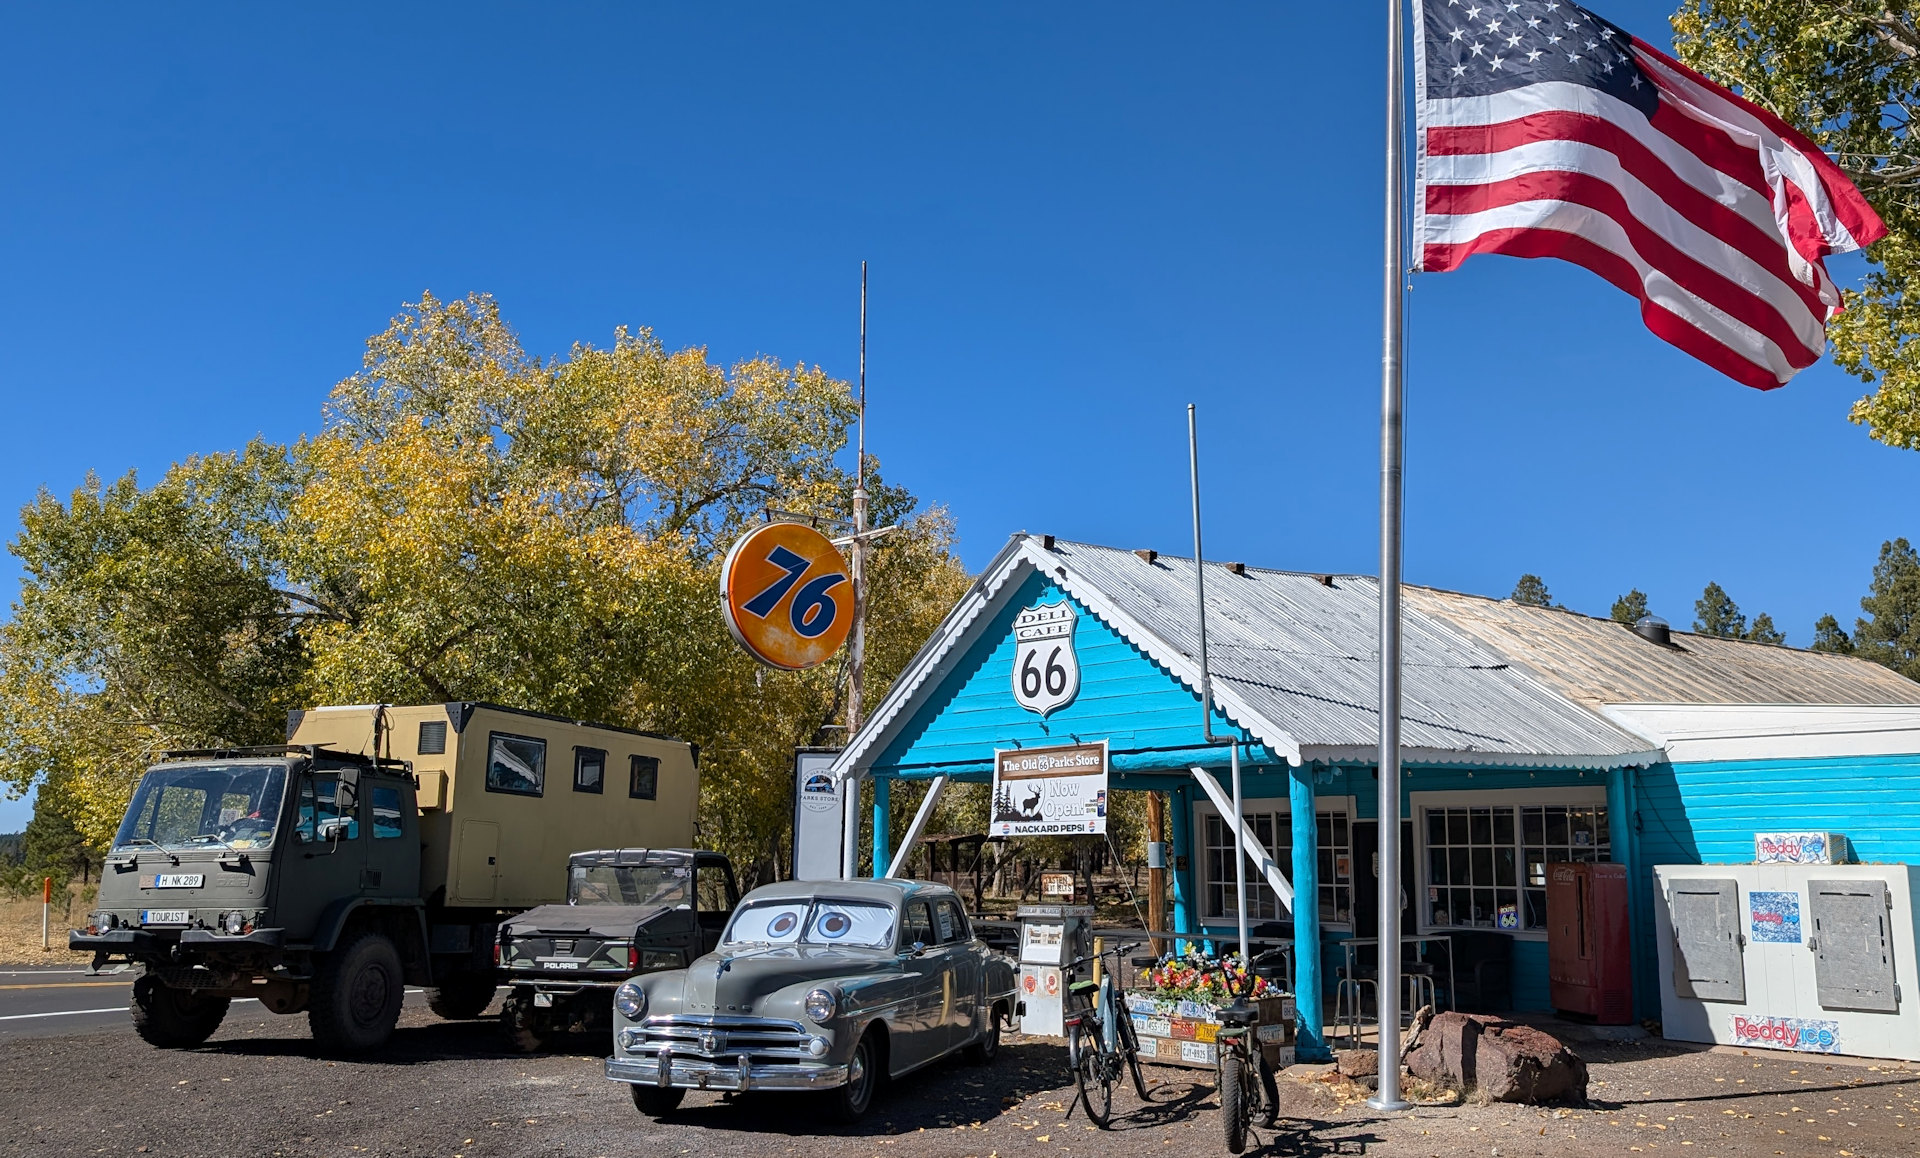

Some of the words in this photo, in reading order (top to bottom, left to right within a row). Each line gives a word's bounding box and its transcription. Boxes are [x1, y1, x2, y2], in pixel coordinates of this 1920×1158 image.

[742, 545, 847, 638] 76
[1021, 610, 1067, 624] DELI
[1019, 625, 1068, 638] CAFE
[1021, 645, 1067, 698] 66
[1003, 760, 1020, 772] The
[1021, 758, 1037, 770] Old
[1039, 763, 1049, 771] 66
[1049, 755, 1075, 769] Parks
[1075, 755, 1100, 766] Store
[1050, 780, 1080, 797] Now
[1044, 798, 1085, 820] Open!
[1015, 823, 1059, 833] NACKARD
[1060, 823, 1085, 832] PEPSI
[1762, 841, 1801, 857] Reddy
[162, 876, 168, 885] H
[172, 876, 184, 885] NK
[184, 876, 199, 886] 289
[151, 912, 185, 922] TOURIST
[1501, 913, 1517, 928] 66
[1752, 912, 1783, 925] Reddy
[543, 962, 579, 970] POLARIS
[1734, 1017, 1799, 1047] Reddy
